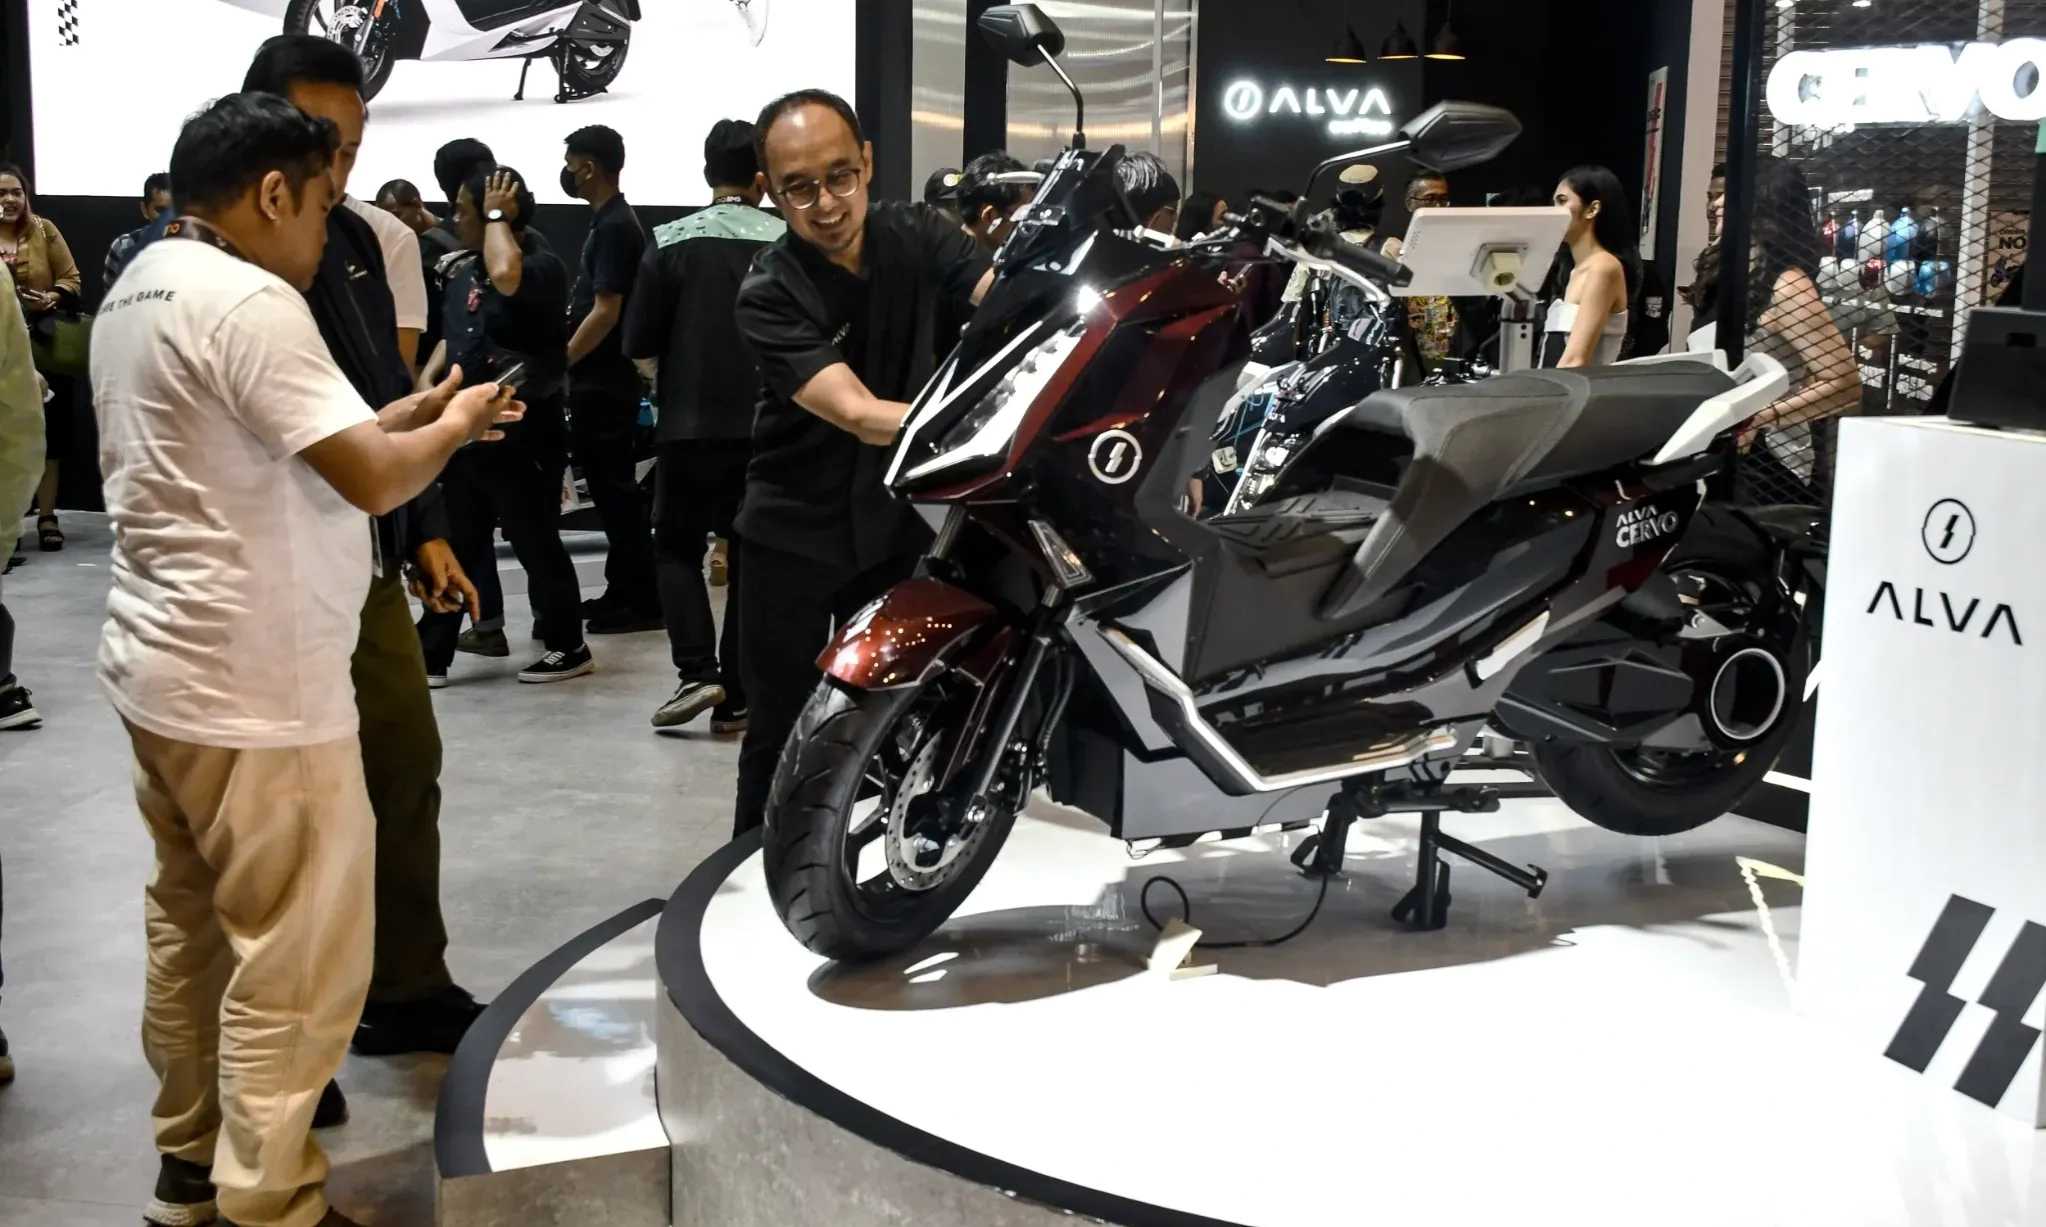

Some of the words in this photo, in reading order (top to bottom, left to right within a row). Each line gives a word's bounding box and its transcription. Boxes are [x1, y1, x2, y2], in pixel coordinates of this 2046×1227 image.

[1269, 87, 1391, 115] ALVA
[136, 289, 175, 302] GAME
[1616, 505, 1657, 527] ALVA
[1616, 511, 1678, 547] CERVO
[1866, 579, 2022, 646] ALVA
